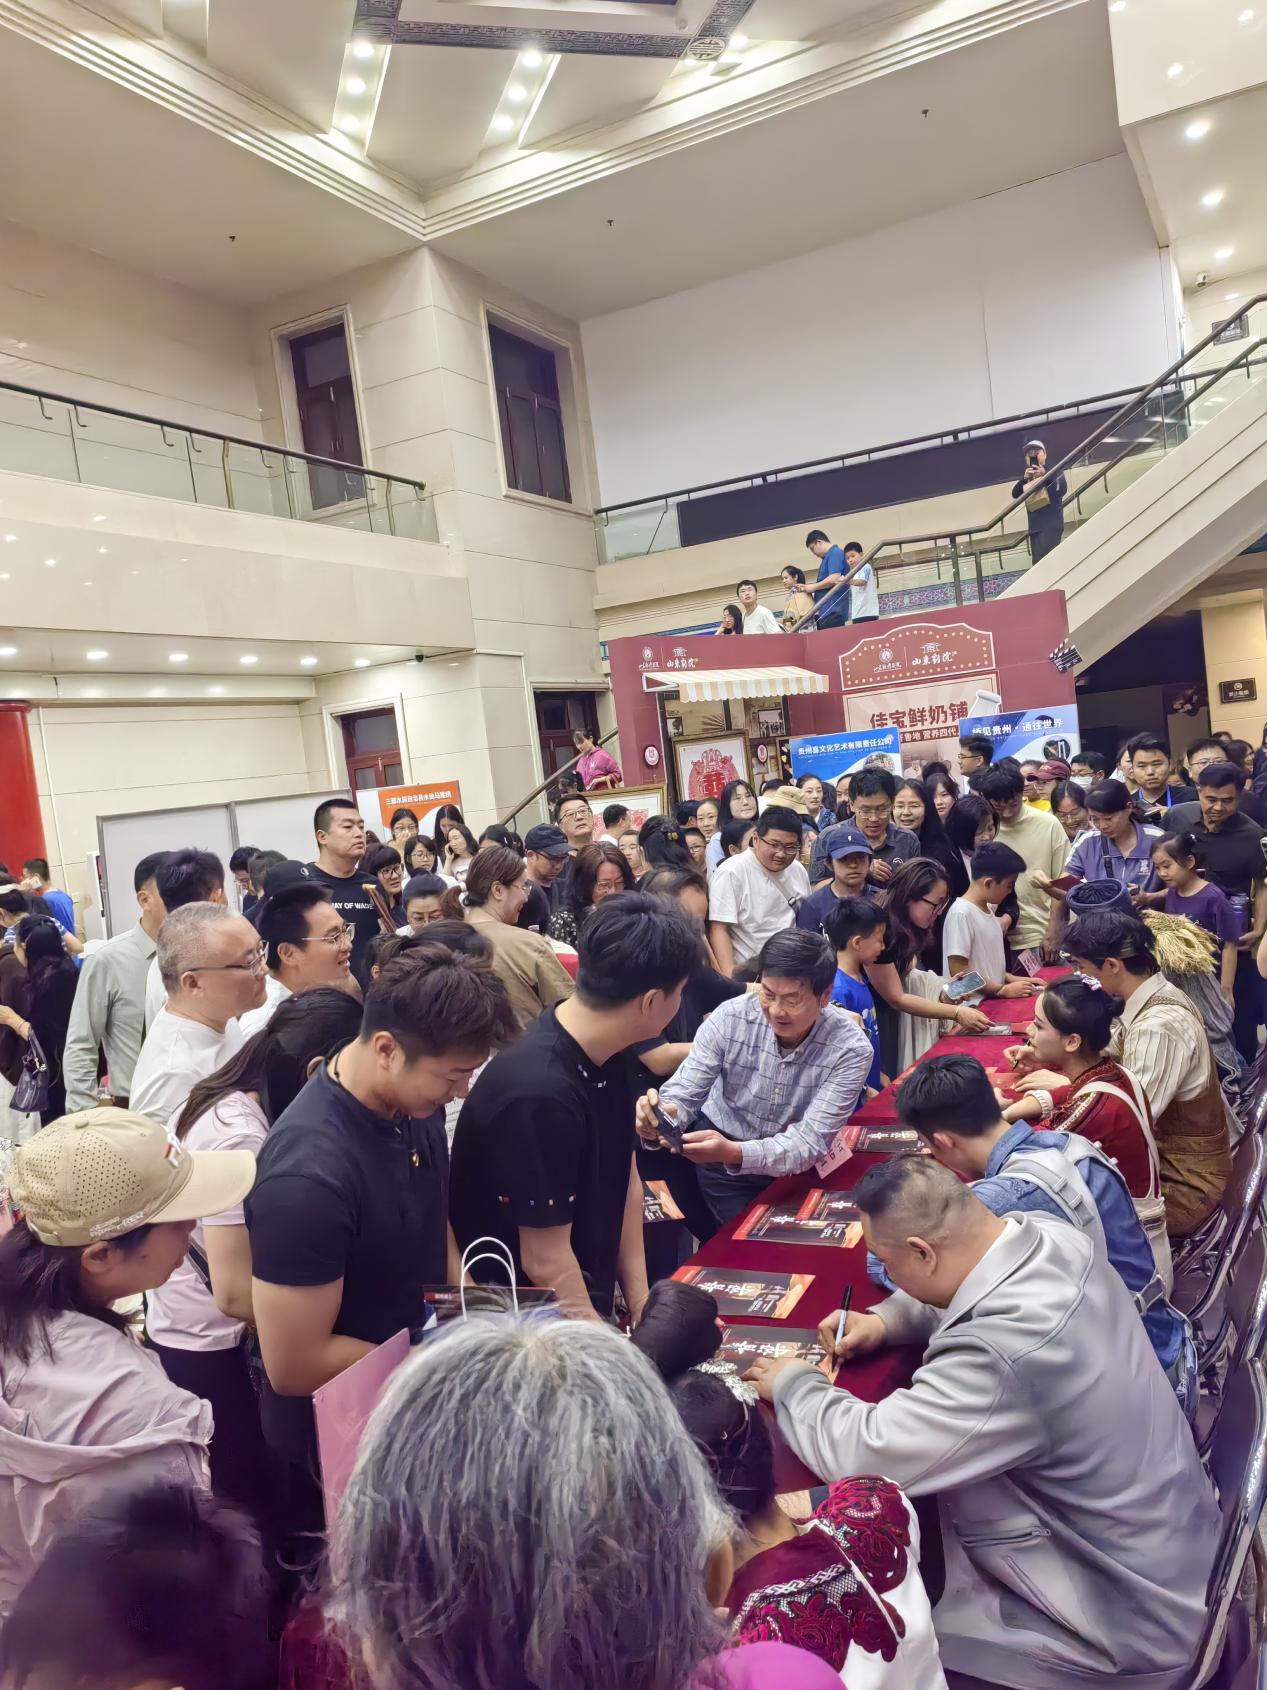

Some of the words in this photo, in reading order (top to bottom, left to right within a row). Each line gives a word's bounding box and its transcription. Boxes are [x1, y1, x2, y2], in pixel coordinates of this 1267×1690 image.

[870, 701, 969, 729] 佳宝鲜奶铺
[923, 726, 959, 740] 营养四代
[331, 902, 343, 910] AY
[344, 902, 354, 910] OF
